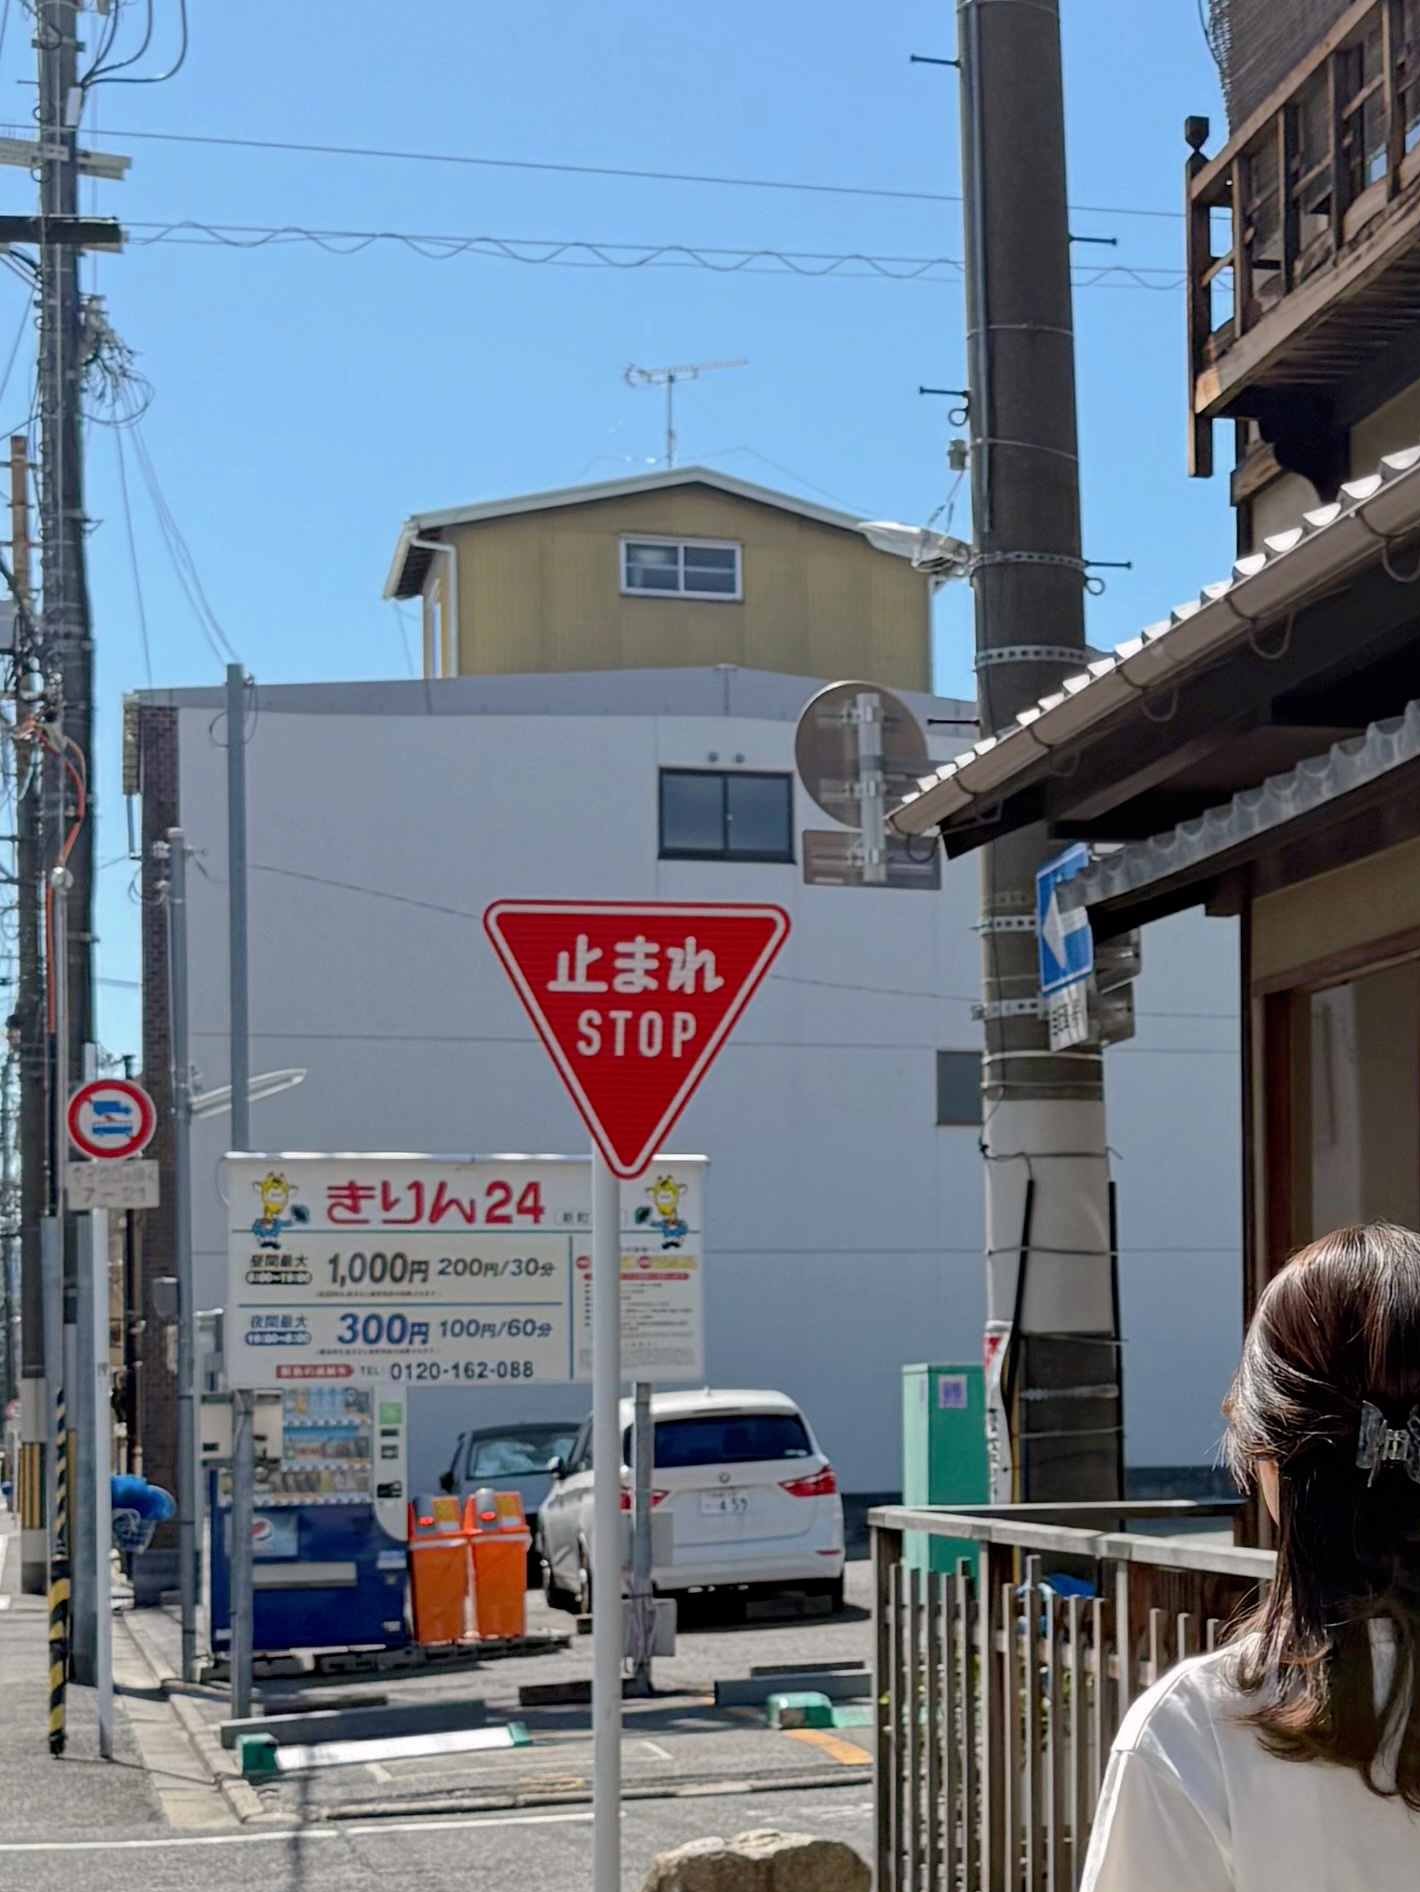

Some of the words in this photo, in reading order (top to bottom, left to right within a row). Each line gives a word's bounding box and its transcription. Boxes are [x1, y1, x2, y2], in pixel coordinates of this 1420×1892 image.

[546, 934, 725, 994] 止まれ
[577, 1009, 697, 1057] STOP
[326, 1179, 546, 1226] きりん24
[327, 1252, 430, 1288] 1,000円
[337, 1313, 430, 1345] 300円
[390, 1361, 534, 1380] 0120-162-088
